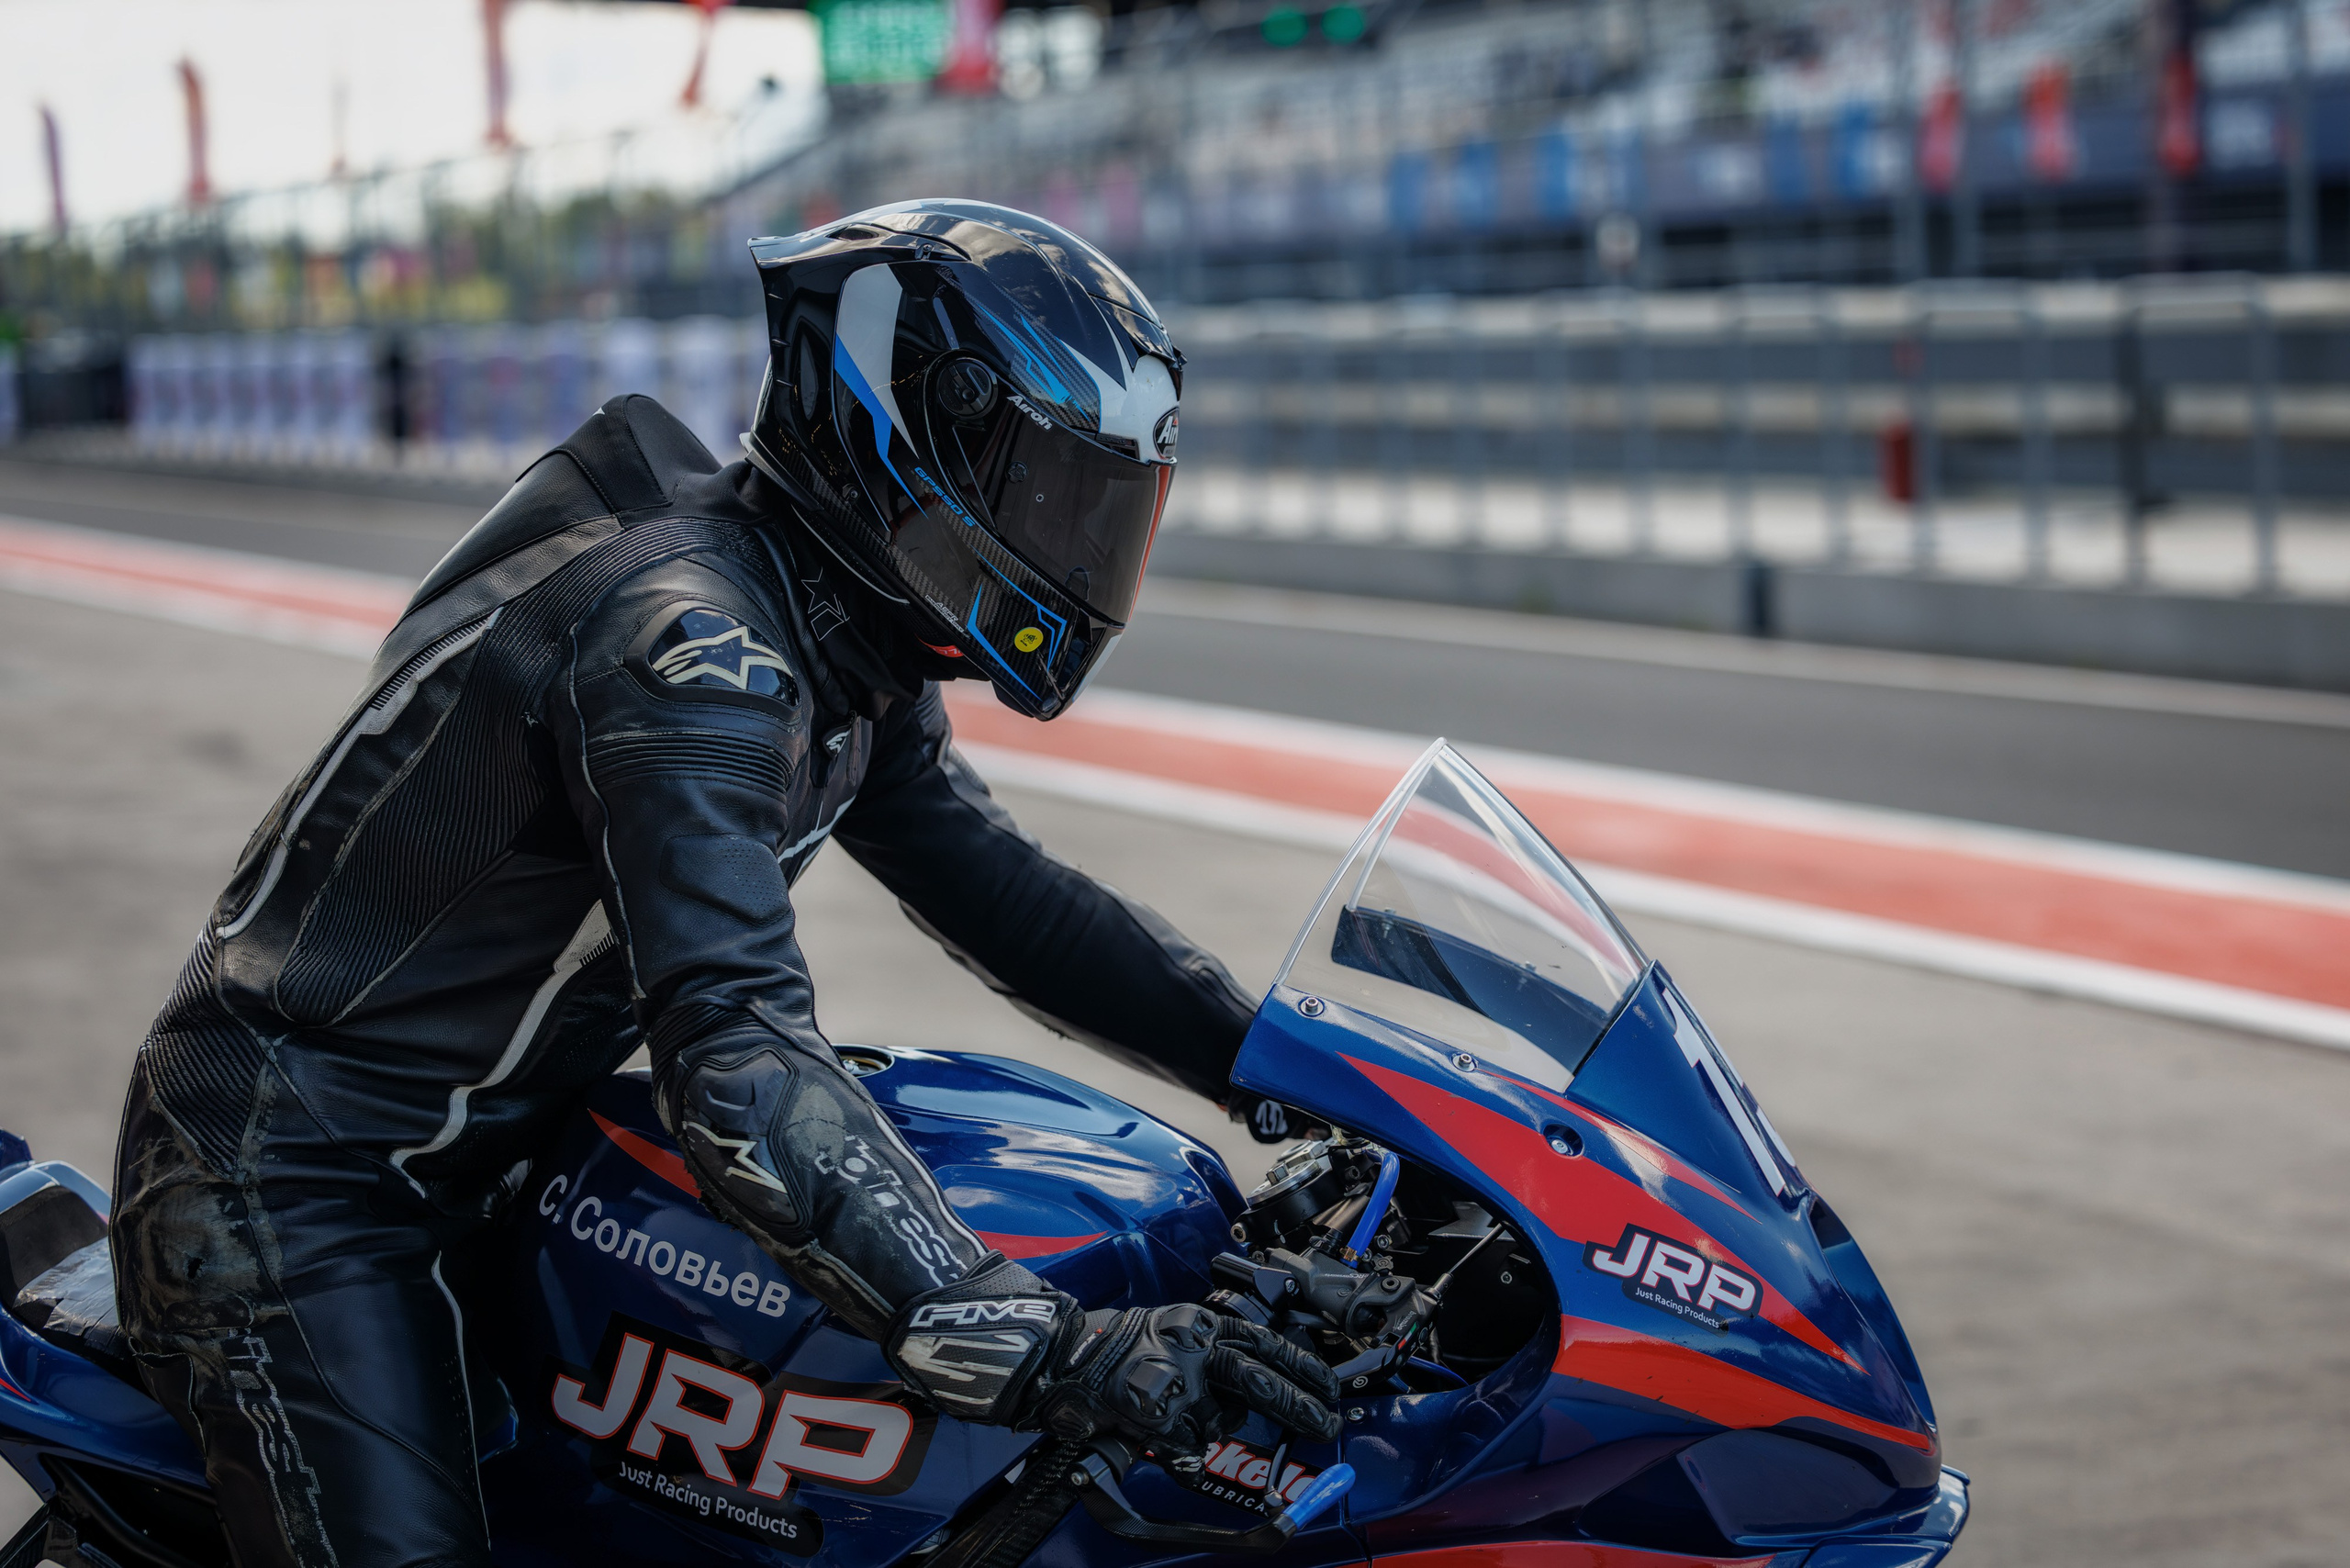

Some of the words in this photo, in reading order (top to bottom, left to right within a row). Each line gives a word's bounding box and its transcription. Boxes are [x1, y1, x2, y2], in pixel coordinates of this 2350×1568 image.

[1006, 396, 1052, 430] Airoh
[914, 466, 964, 515] GP550
[962, 516, 976, 527] S
[539, 1174, 568, 1225] С.
[570, 1196, 791, 1317] Соловьев
[1592, 1232, 1756, 1311] JRP
[1635, 1287, 1653, 1301] Just
[1655, 1294, 1683, 1314] Racing
[1684, 1305, 1719, 1328] Products
[551, 1332, 914, 1501] JRP
[619, 1462, 654, 1489] Just
[655, 1473, 711, 1516] Racing
[715, 1496, 798, 1539] Products
[1193, 1481, 1270, 1518] UBRICA
